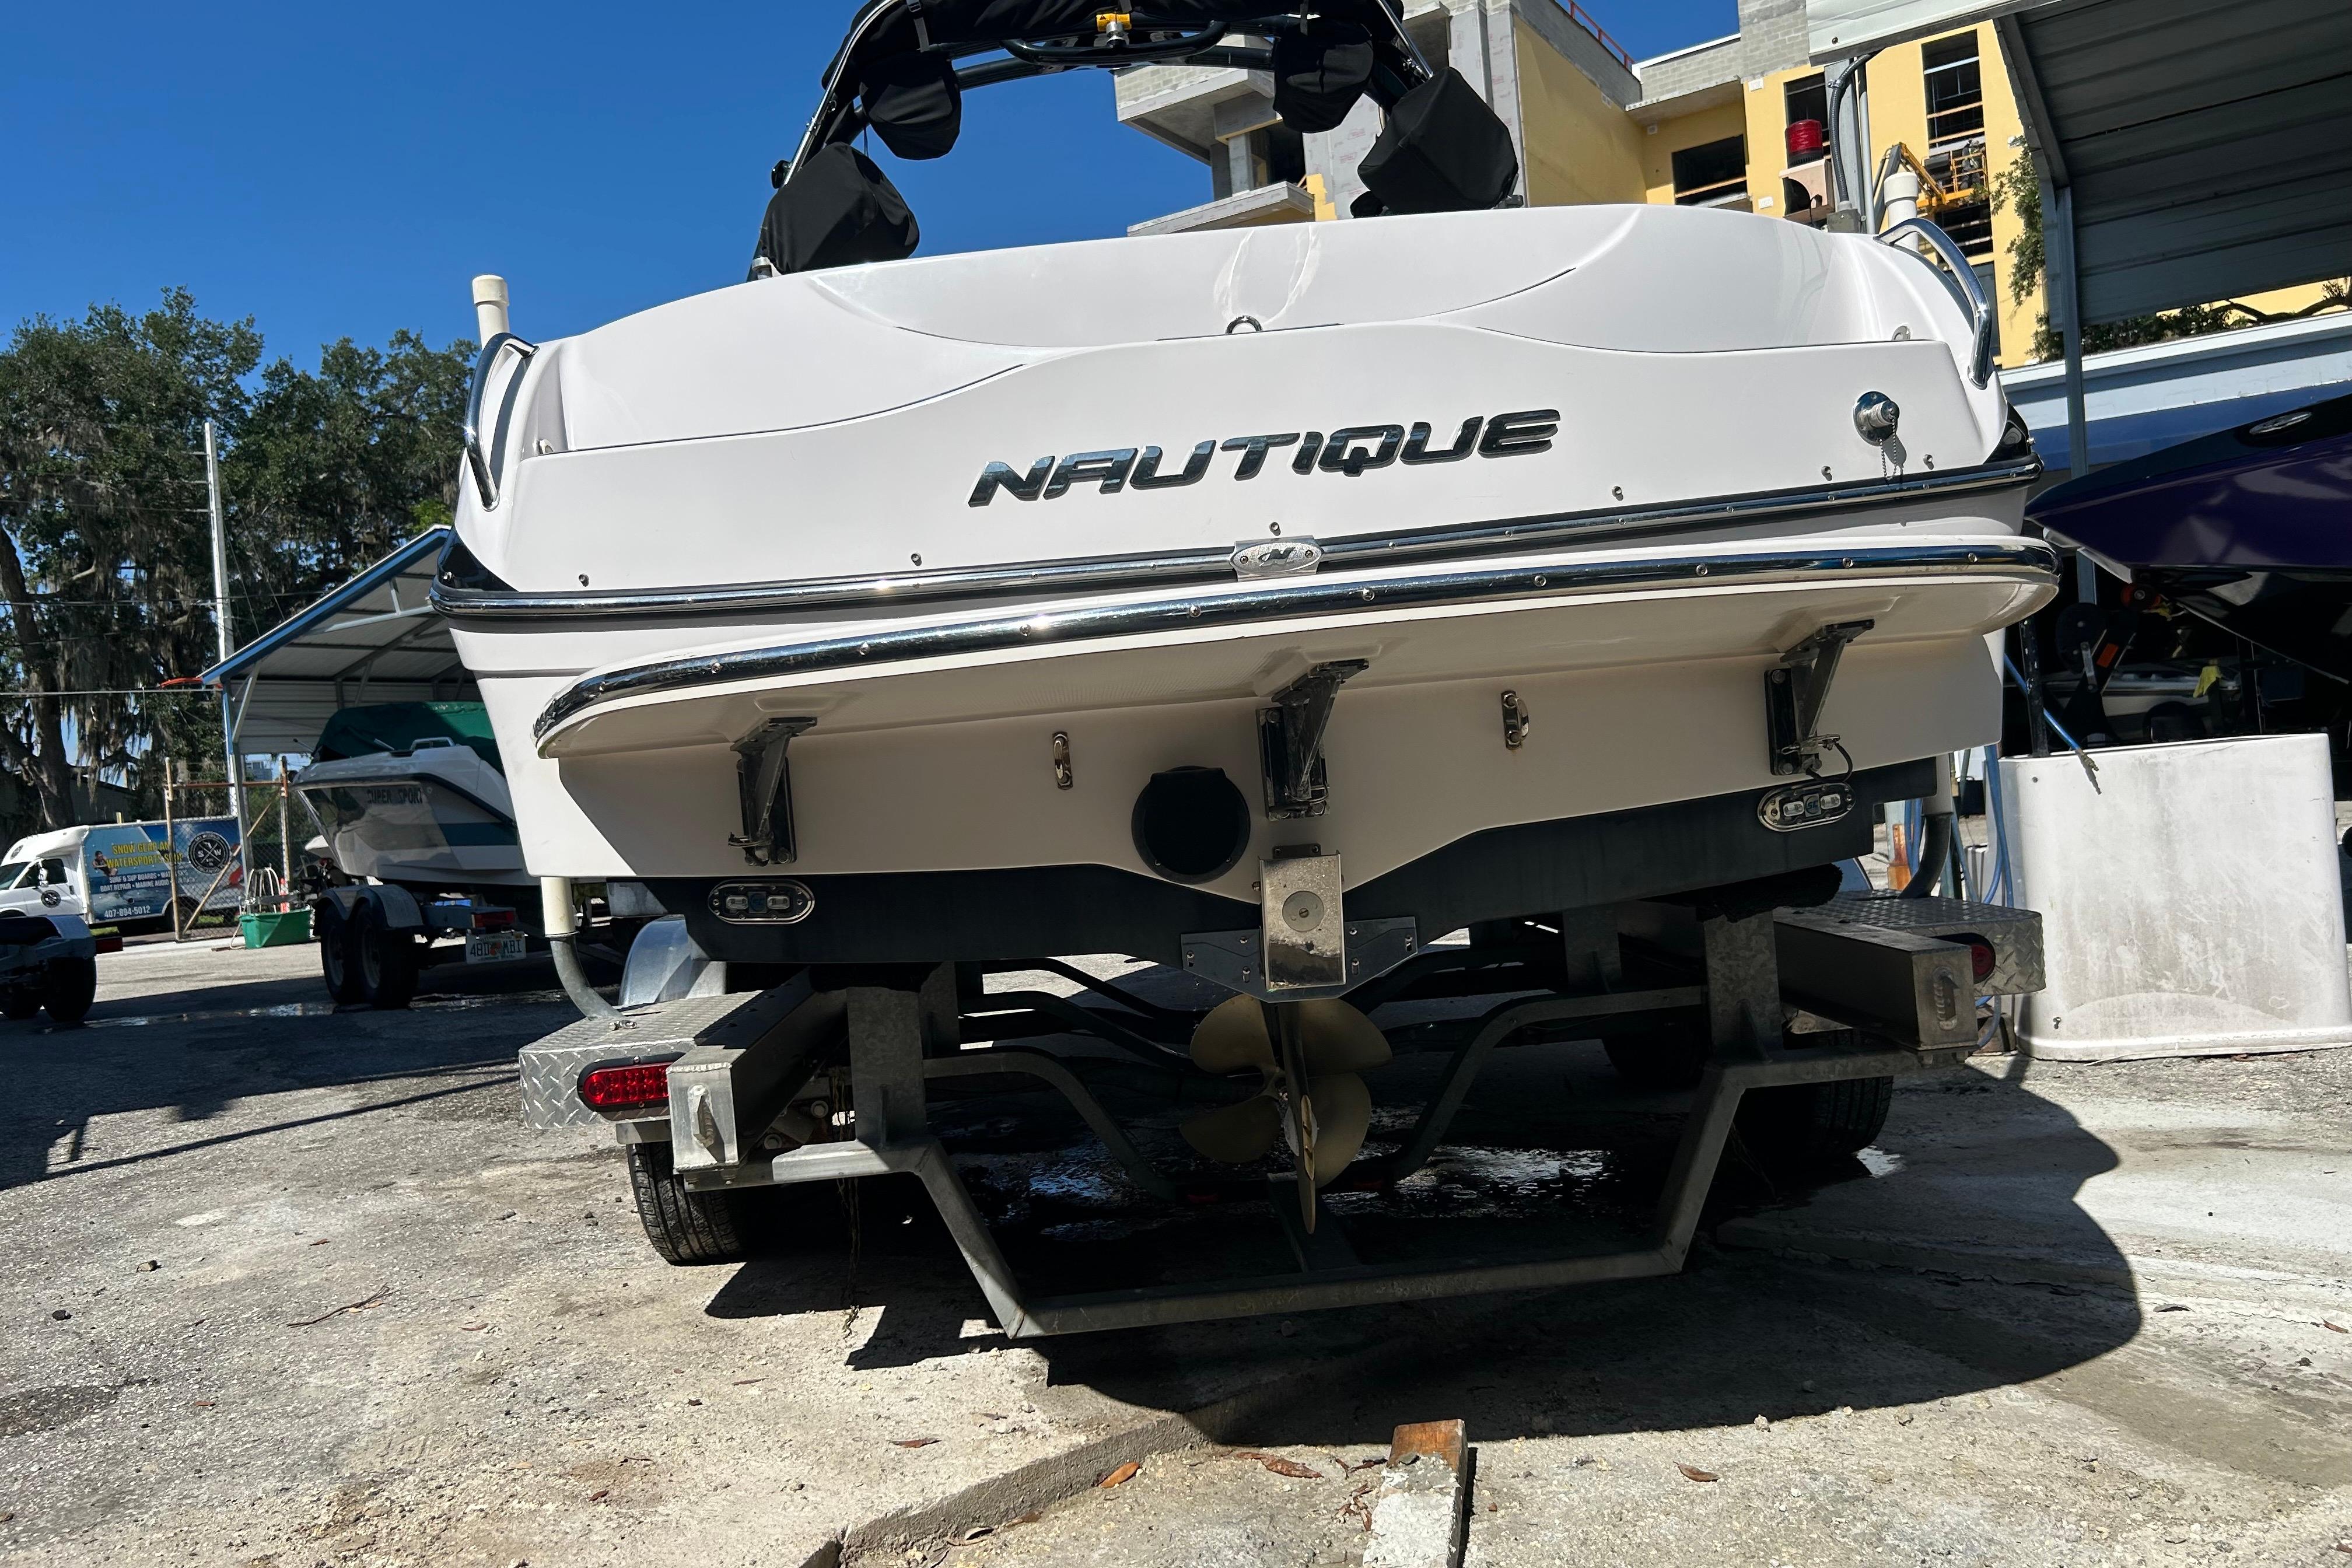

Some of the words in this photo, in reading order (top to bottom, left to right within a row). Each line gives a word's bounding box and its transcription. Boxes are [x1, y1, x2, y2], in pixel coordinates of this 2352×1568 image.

[968, 409, 1560, 507] NAUTIQUE
[397, 787, 423, 804] SPORT
[112, 843, 135, 855] SNOW
[160, 841, 173, 851] AN
[106, 853, 163, 869] WATERSPORTS
[109, 875, 122, 883] SURF
[138, 872, 157, 881] BOARDS
[114, 883, 132, 891] REPAIR
[135, 880, 155, 888] MARINE
[155, 878, 169, 887] AUDIO
[104, 905, 151, 918] 407-894-5012
[503, 939, 522, 954] MBI
